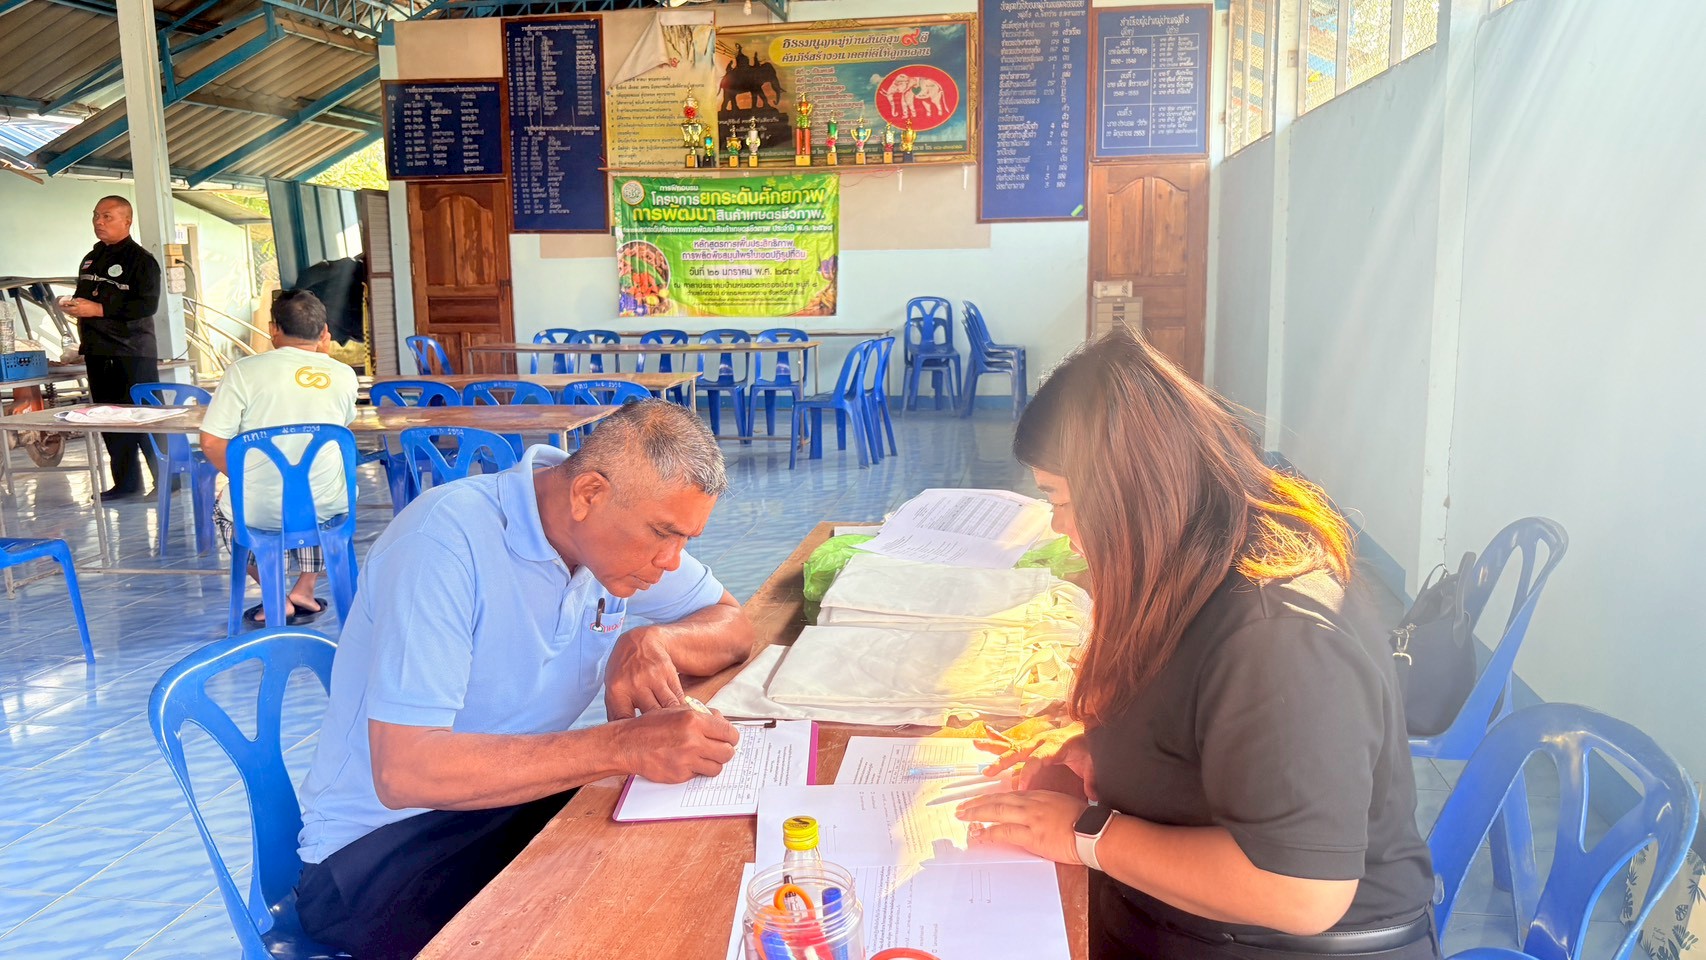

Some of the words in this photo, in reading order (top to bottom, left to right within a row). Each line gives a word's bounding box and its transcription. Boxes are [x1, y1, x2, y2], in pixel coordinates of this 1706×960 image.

[901, 29, 920, 47] ๙
[694, 238, 793, 249] หลักสูตรการเพิ่มประสิทธิภาพ
[682, 250, 806, 261] การผลิตพืชสมุนไพรในเขตปฏิรูปที่ดิน
[689, 264, 704, 276] วันที่
